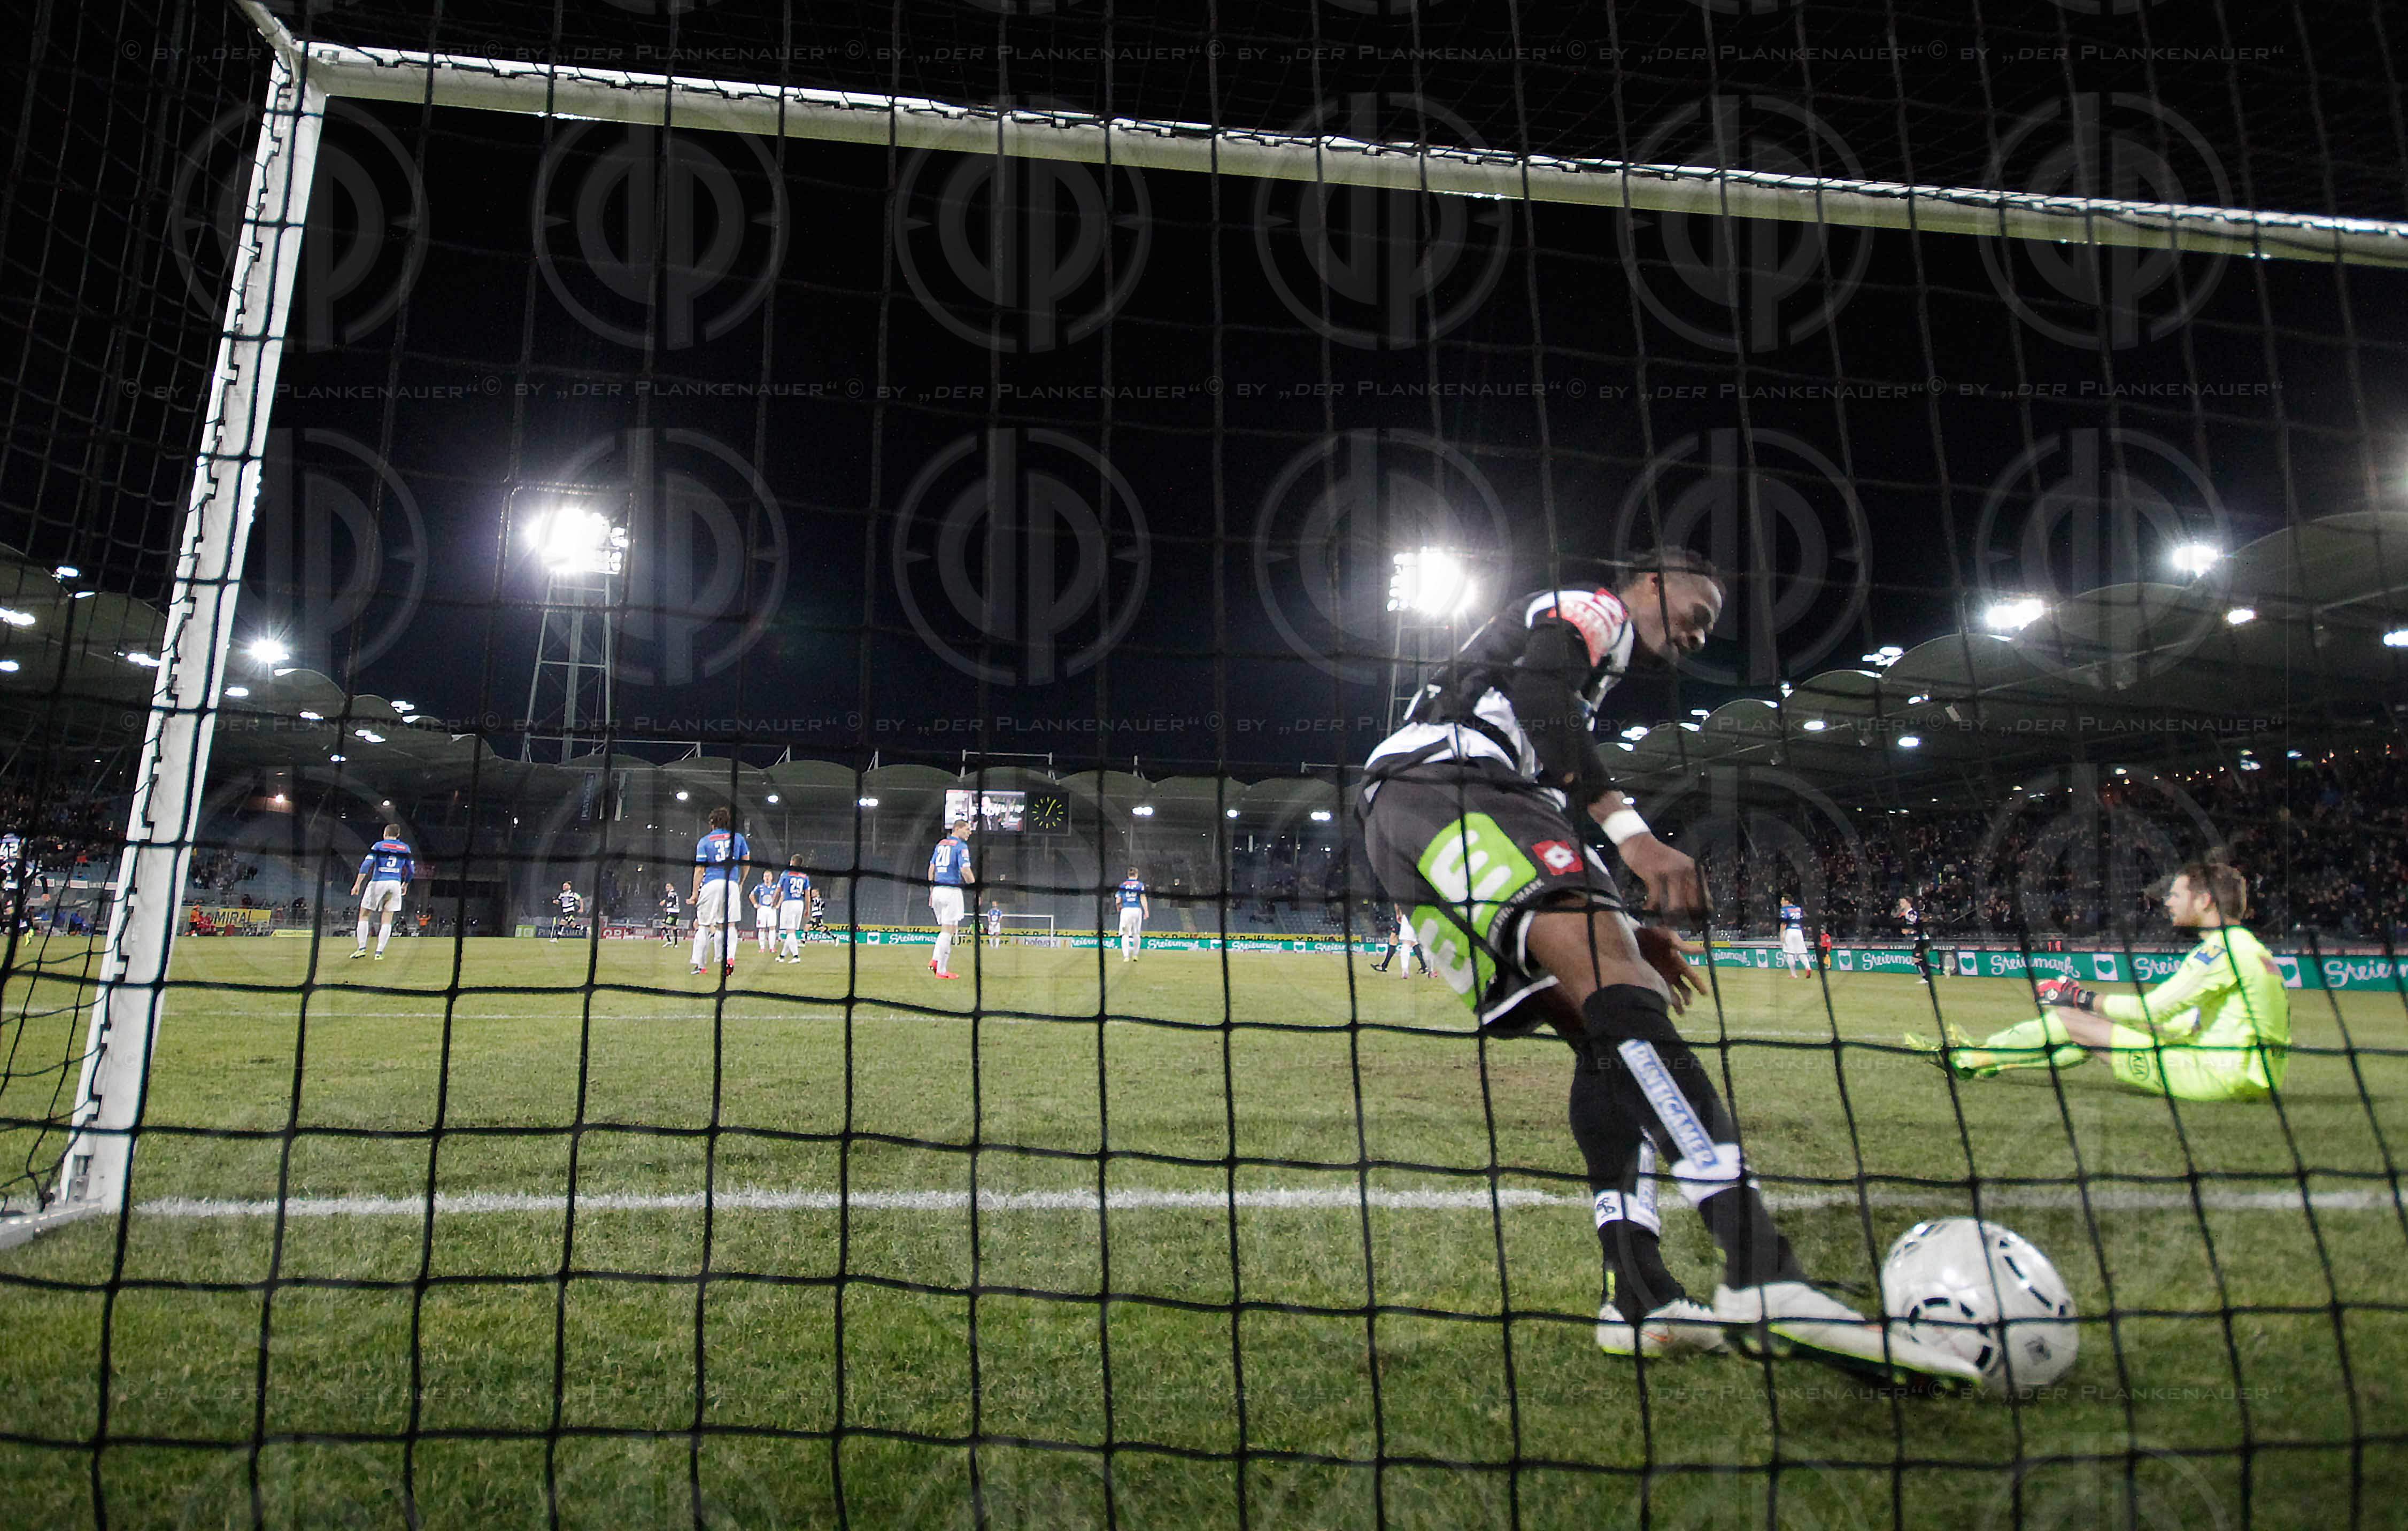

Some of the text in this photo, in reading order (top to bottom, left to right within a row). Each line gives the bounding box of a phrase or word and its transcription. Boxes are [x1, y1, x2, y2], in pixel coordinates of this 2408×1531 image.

[936, 845, 951, 867] 20
[790, 878, 804, 898] 29
[889, 934, 938, 945] Steierma
[1862, 952, 1915, 971] Steierma
[1990, 954, 2081, 978] Steiemark
